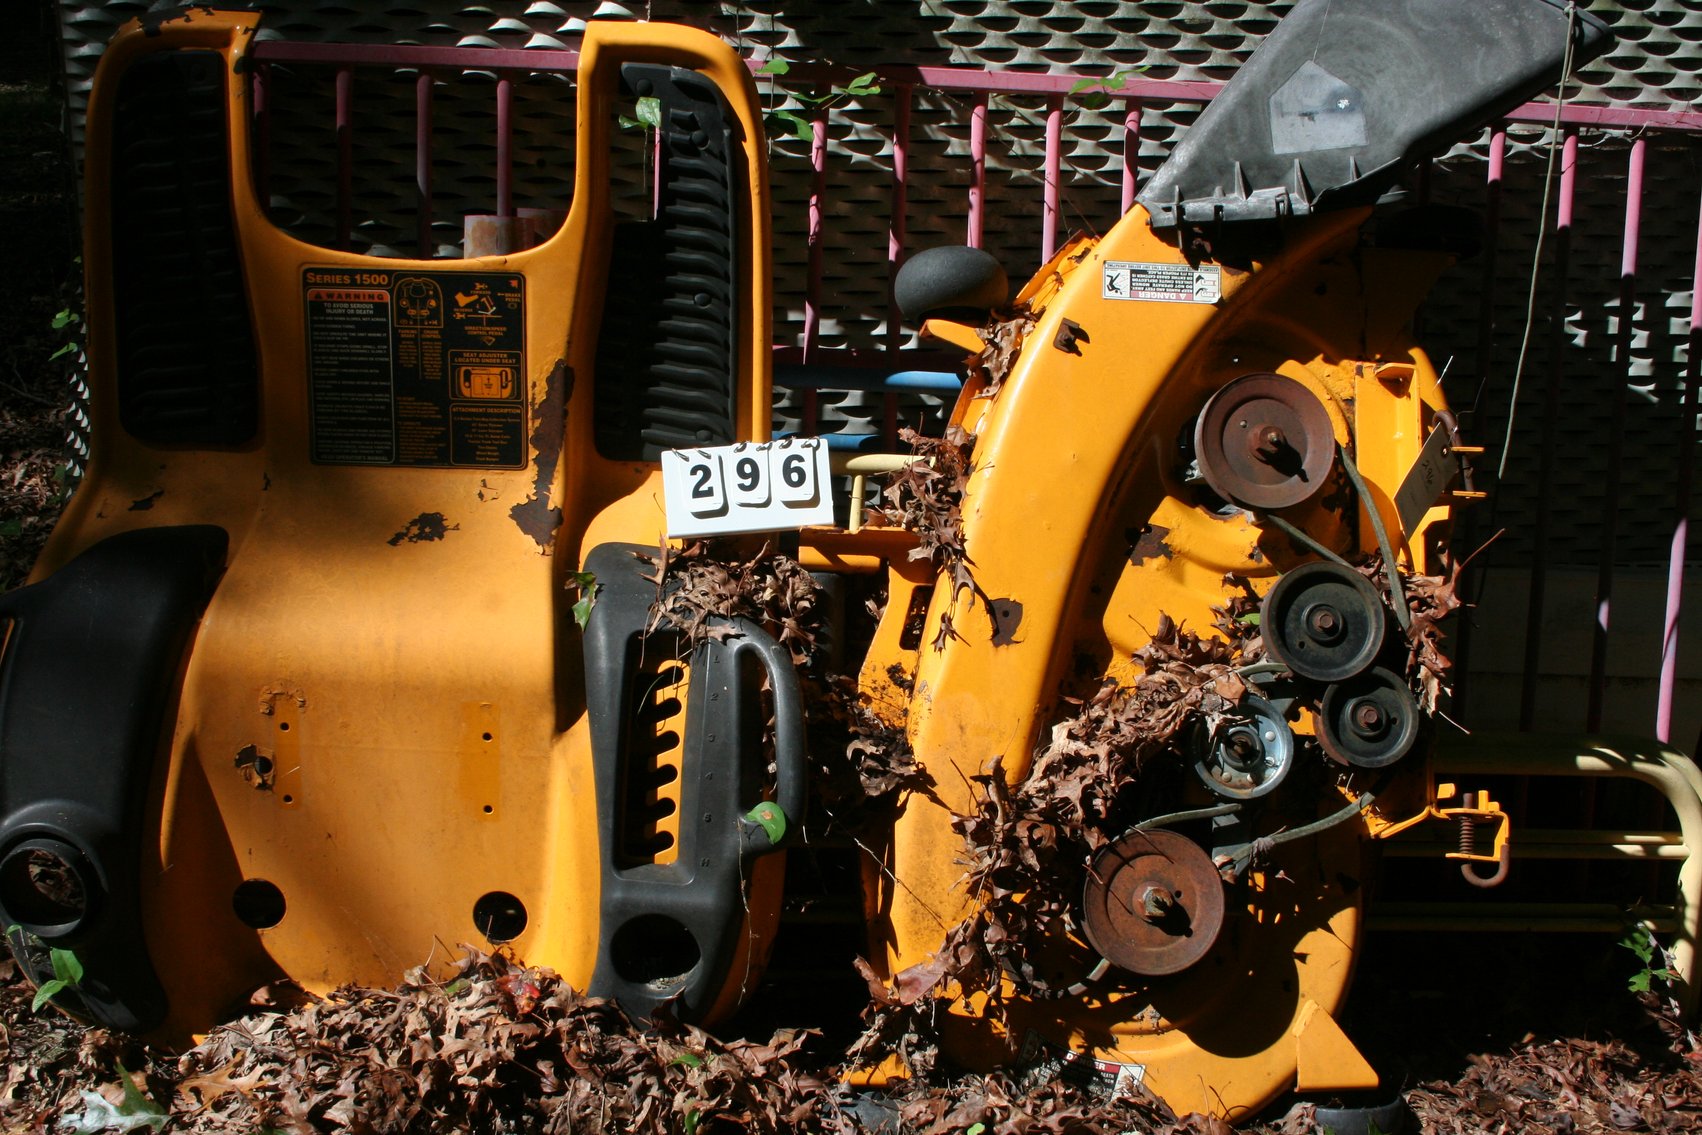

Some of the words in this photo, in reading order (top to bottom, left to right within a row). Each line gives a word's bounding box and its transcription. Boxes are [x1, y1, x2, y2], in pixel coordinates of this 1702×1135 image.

[306, 272, 351, 284] SERIES
[355, 273, 388, 285] 1500
[689, 453, 807, 499] 296
[711, 692, 719, 701] 2
[708, 733, 716, 743] 3
[1066, 1052, 1106, 1071] DAER
